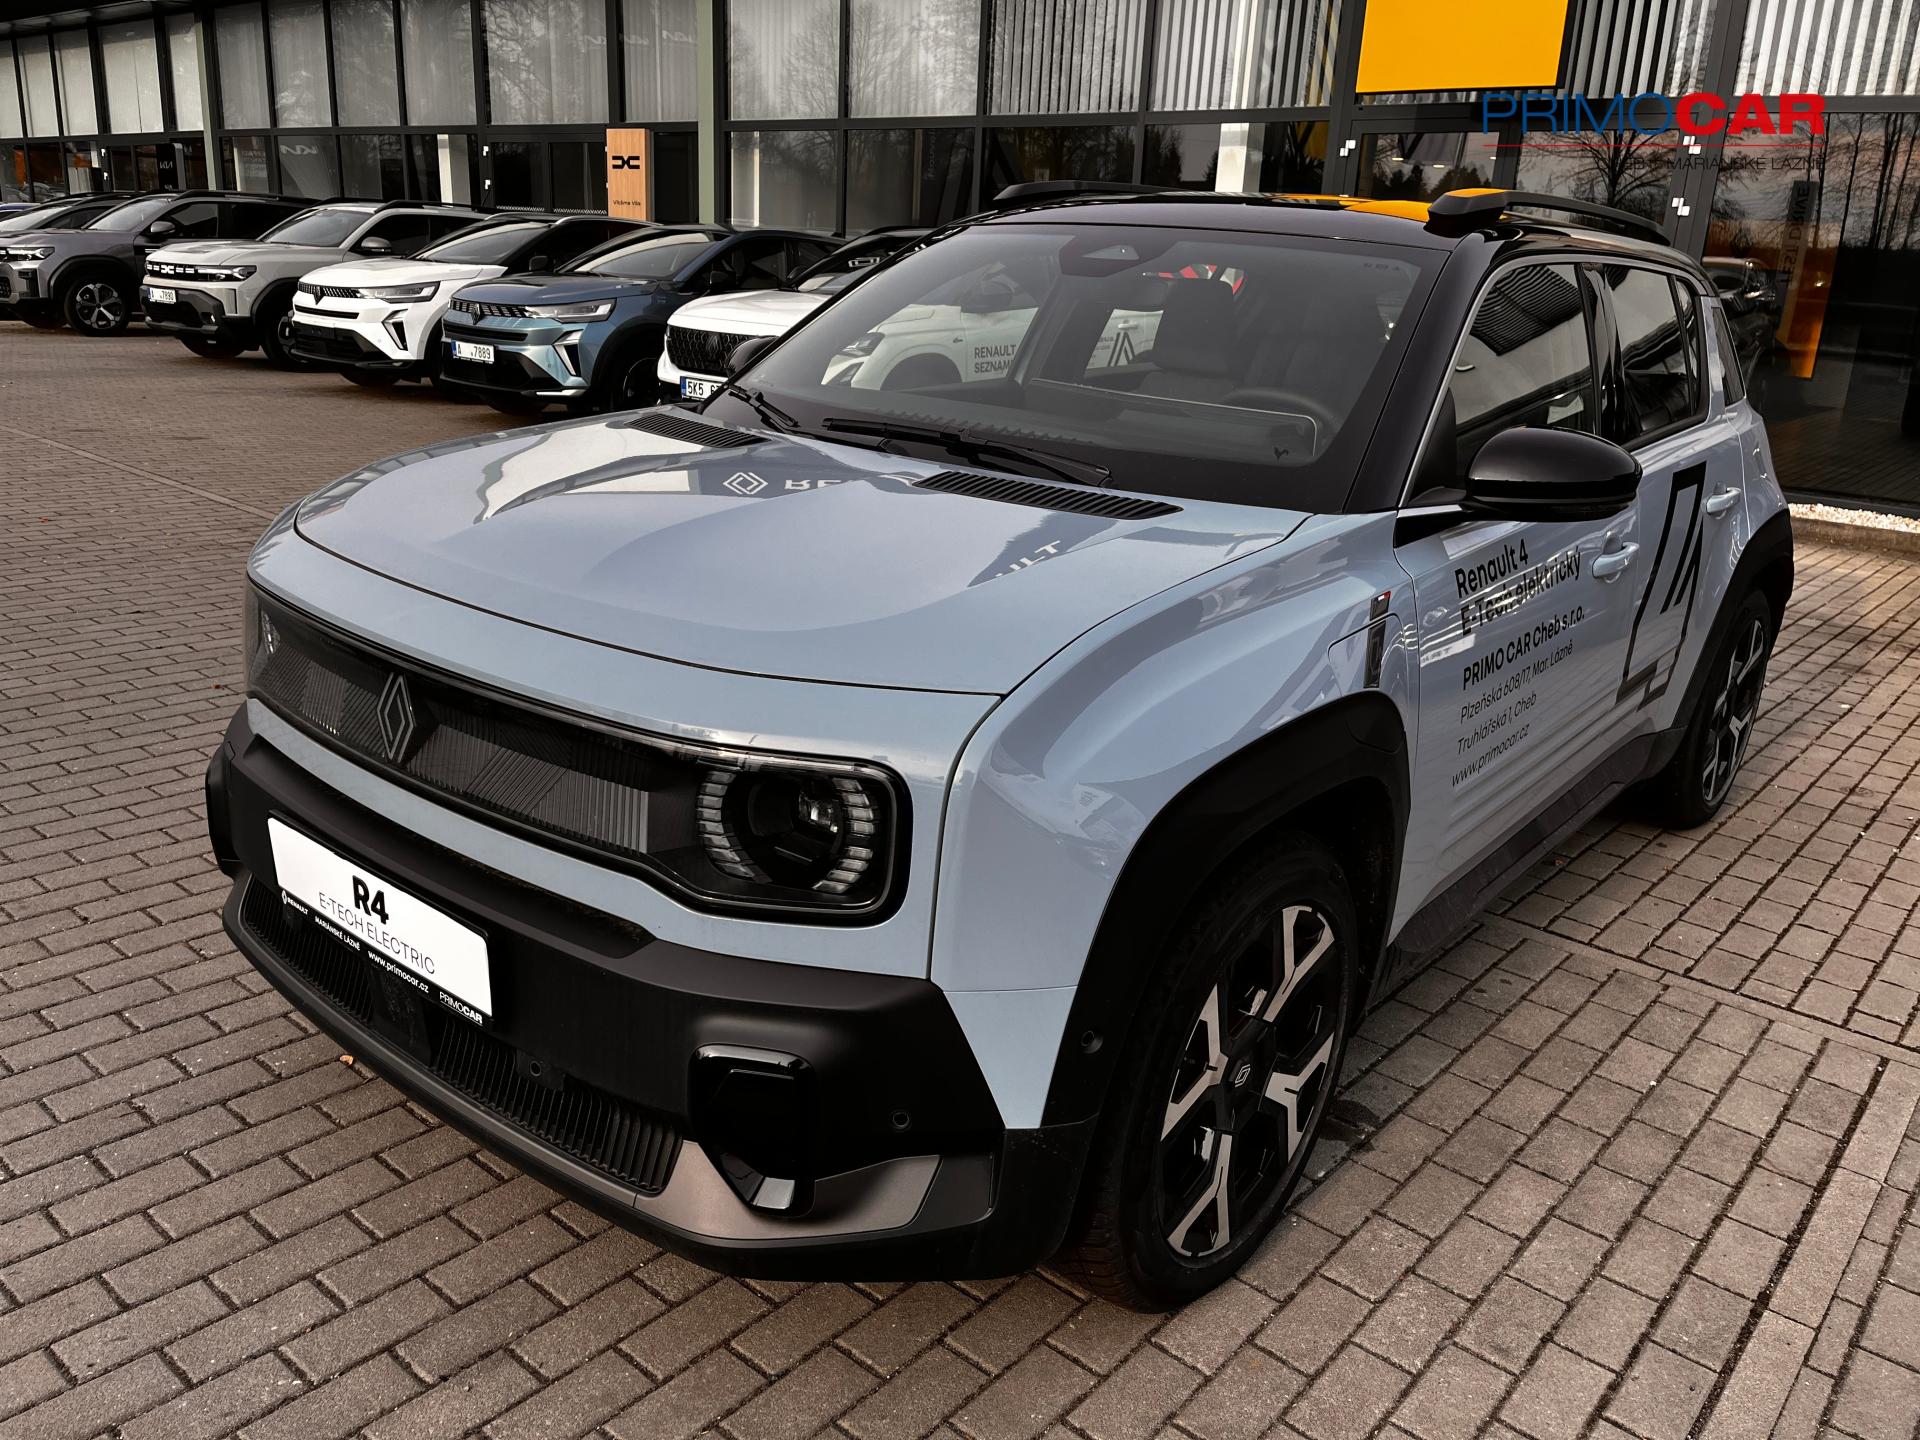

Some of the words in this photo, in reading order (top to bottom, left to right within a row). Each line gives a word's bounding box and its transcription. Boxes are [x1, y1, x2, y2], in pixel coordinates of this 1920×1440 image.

[974, 344, 1016, 359] RENAULT
[687, 381, 704, 396] 5K5
[1455, 544, 1518, 599] Renault
[1519, 538, 1528, 565] 4
[1515, 546, 1581, 603] elektrický
[1463, 647, 1505, 691] PRIMO
[1506, 631, 1532, 664] CAR
[1533, 614, 1562, 649] Cheb
[1561, 605, 1586, 632] s.r.o.
[1460, 682, 1502, 725] Plzeňská
[1513, 691, 1538, 719] Cheb
[1452, 723, 1530, 788] www.primocar.cz
[352, 874, 390, 925] R4
[318, 891, 364, 934] E-TECH
[366, 921, 436, 976] ELECTRIC
[367, 950, 430, 994] www.primocar.cz
[439, 991, 483, 1025] PRIMOCAR
